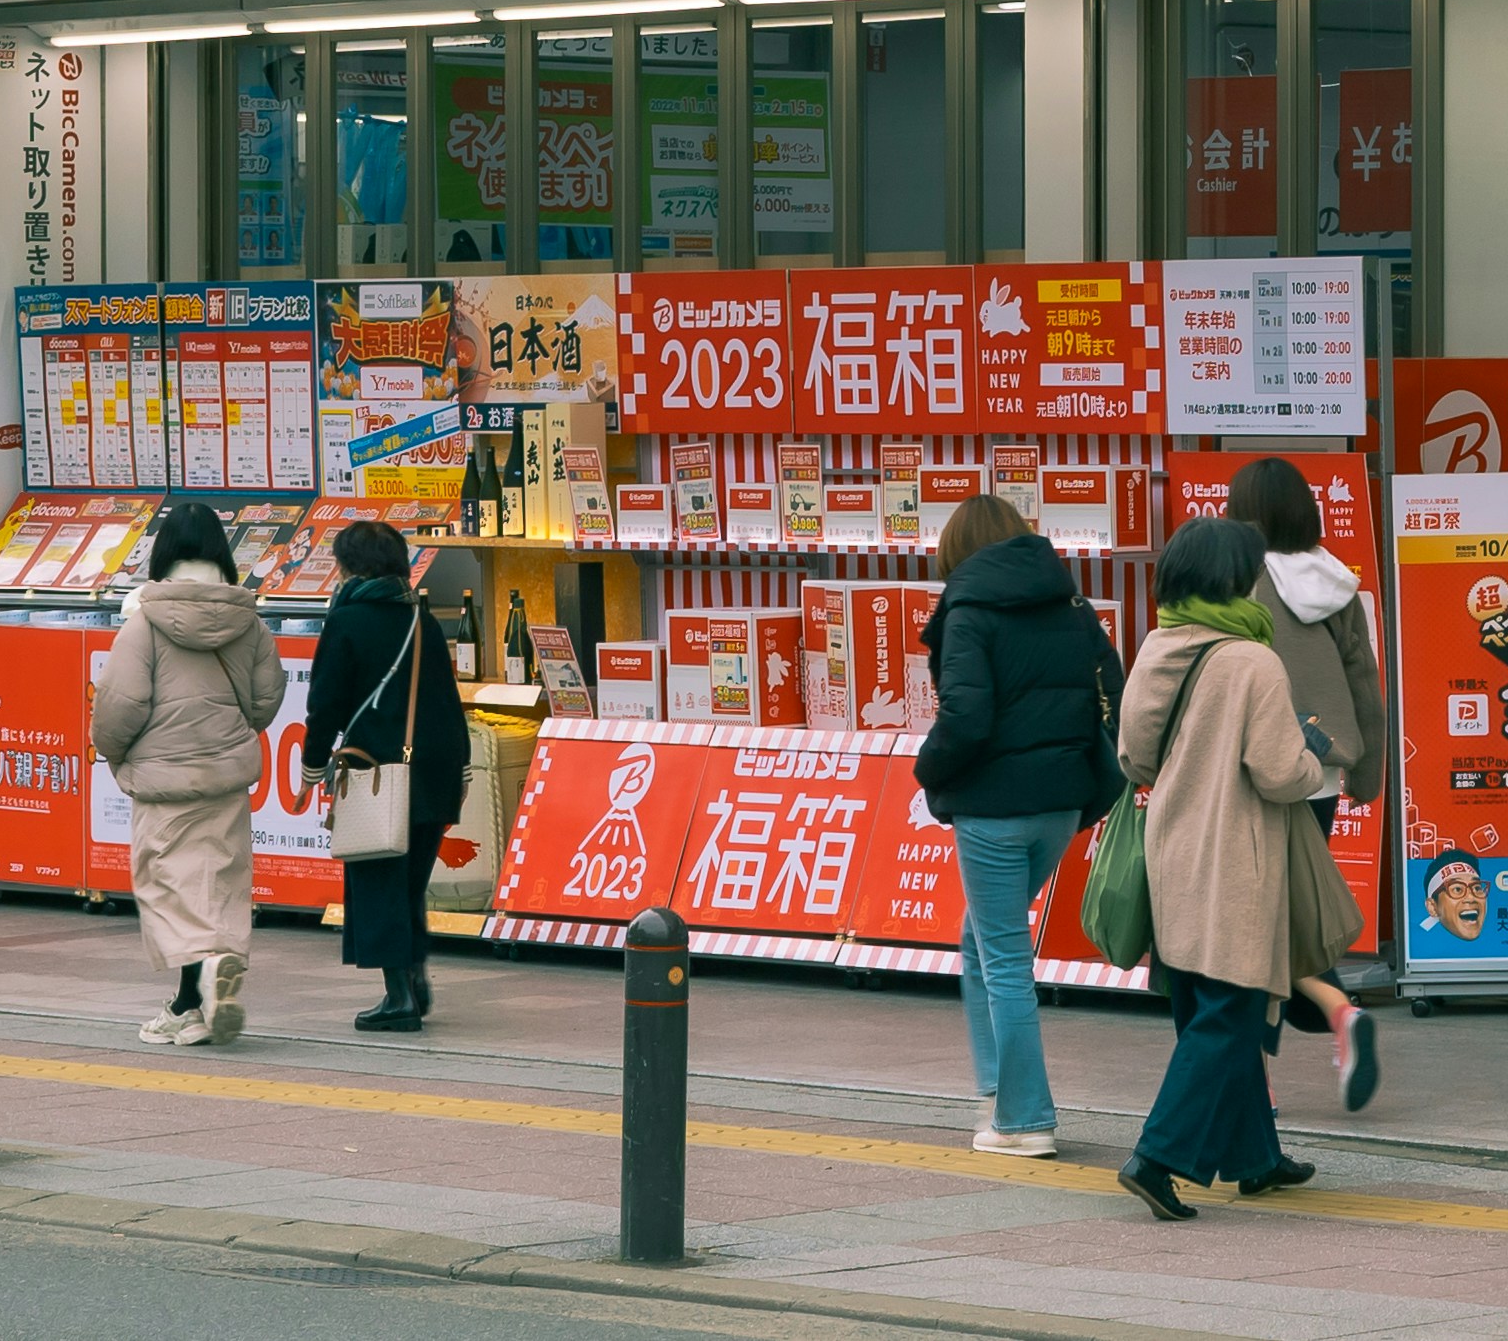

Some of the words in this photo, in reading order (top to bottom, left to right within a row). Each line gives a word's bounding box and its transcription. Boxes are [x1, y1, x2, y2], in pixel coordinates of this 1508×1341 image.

[1197, 177, 1237, 193] Cashier
[1060, 283, 1099, 298] 受付時間
[377, 291, 417, 311] SoftBank
[516, 294, 554, 311] 日本の心
[679, 298, 782, 327] ビックカメラ
[1046, 309, 1102, 327] 元旦朝から
[1184, 310, 1236, 330] 年末年始
[331, 313, 451, 369] 大感謝祭
[488, 317, 583, 376] 日本酒
[1047, 329, 1115, 357] 朝9時まで
[1179, 336, 1243, 355] 営業時間の
[803, 288, 965, 415] 福箱
[981, 349, 1027, 365] HAPPY
[660, 336, 785, 410] 2023
[989, 373, 1020, 389] NEW
[1062, 367, 1101, 382] 販売開始
[1192, 361, 1231, 381] ご案内
[987, 397, 1024, 413] YEAR
[1036, 392, 1128, 418] 元旦朝10時より
[31, 503, 76, 519] docomo
[733, 748, 862, 781] ビックカメラ
[688, 789, 867, 916] 福箱
[897, 843, 954, 864] HAPPY
[563, 852, 647, 901] 2023
[899, 871, 938, 892] NEW
[891, 900, 935, 920] YEAR
